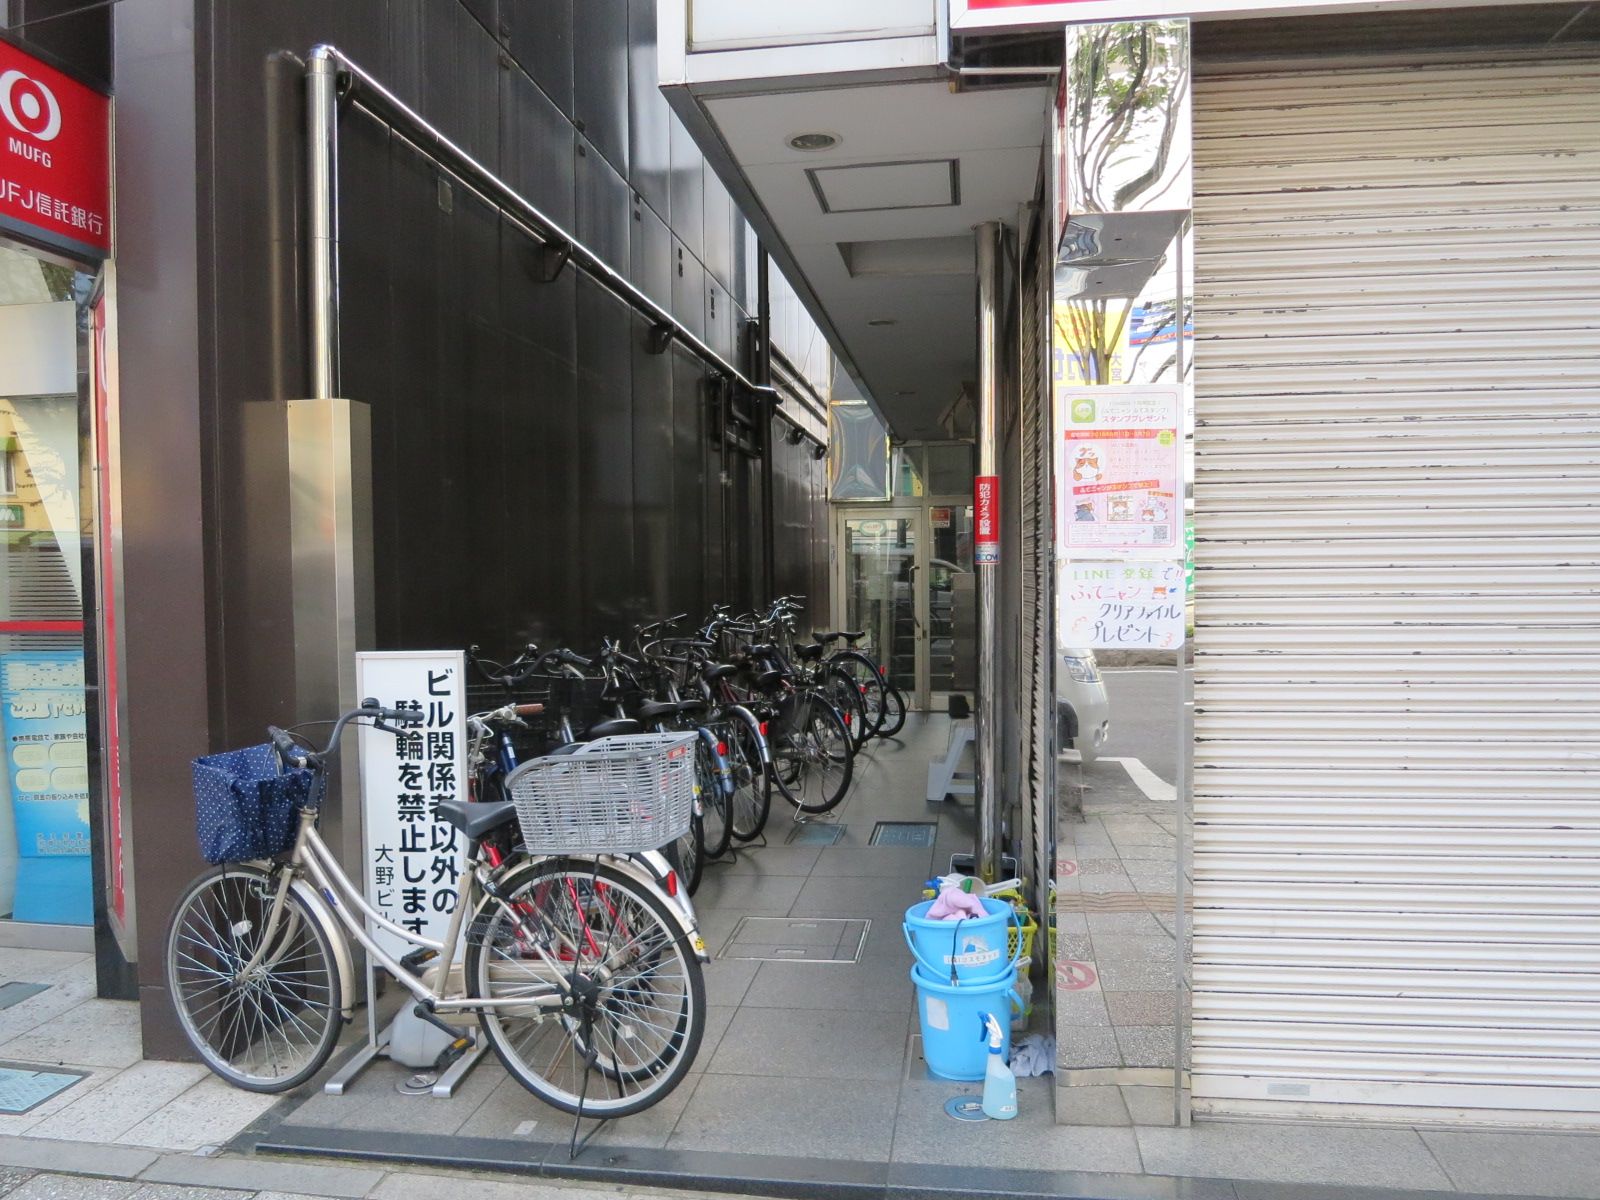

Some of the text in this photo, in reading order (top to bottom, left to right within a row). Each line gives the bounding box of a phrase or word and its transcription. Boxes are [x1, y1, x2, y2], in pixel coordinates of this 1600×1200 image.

[9, 137, 52, 168] MUFG
[979, 483, 991, 535] 防犯カメラ設置
[1073, 568, 1114, 580] LINE
[1071, 584, 1141, 600] ふてニャン
[1100, 603, 1181, 620] クリアファイル
[427, 668, 459, 915] ビル関係者以外の
[395, 699, 429, 945] 駐輪を禁止します
